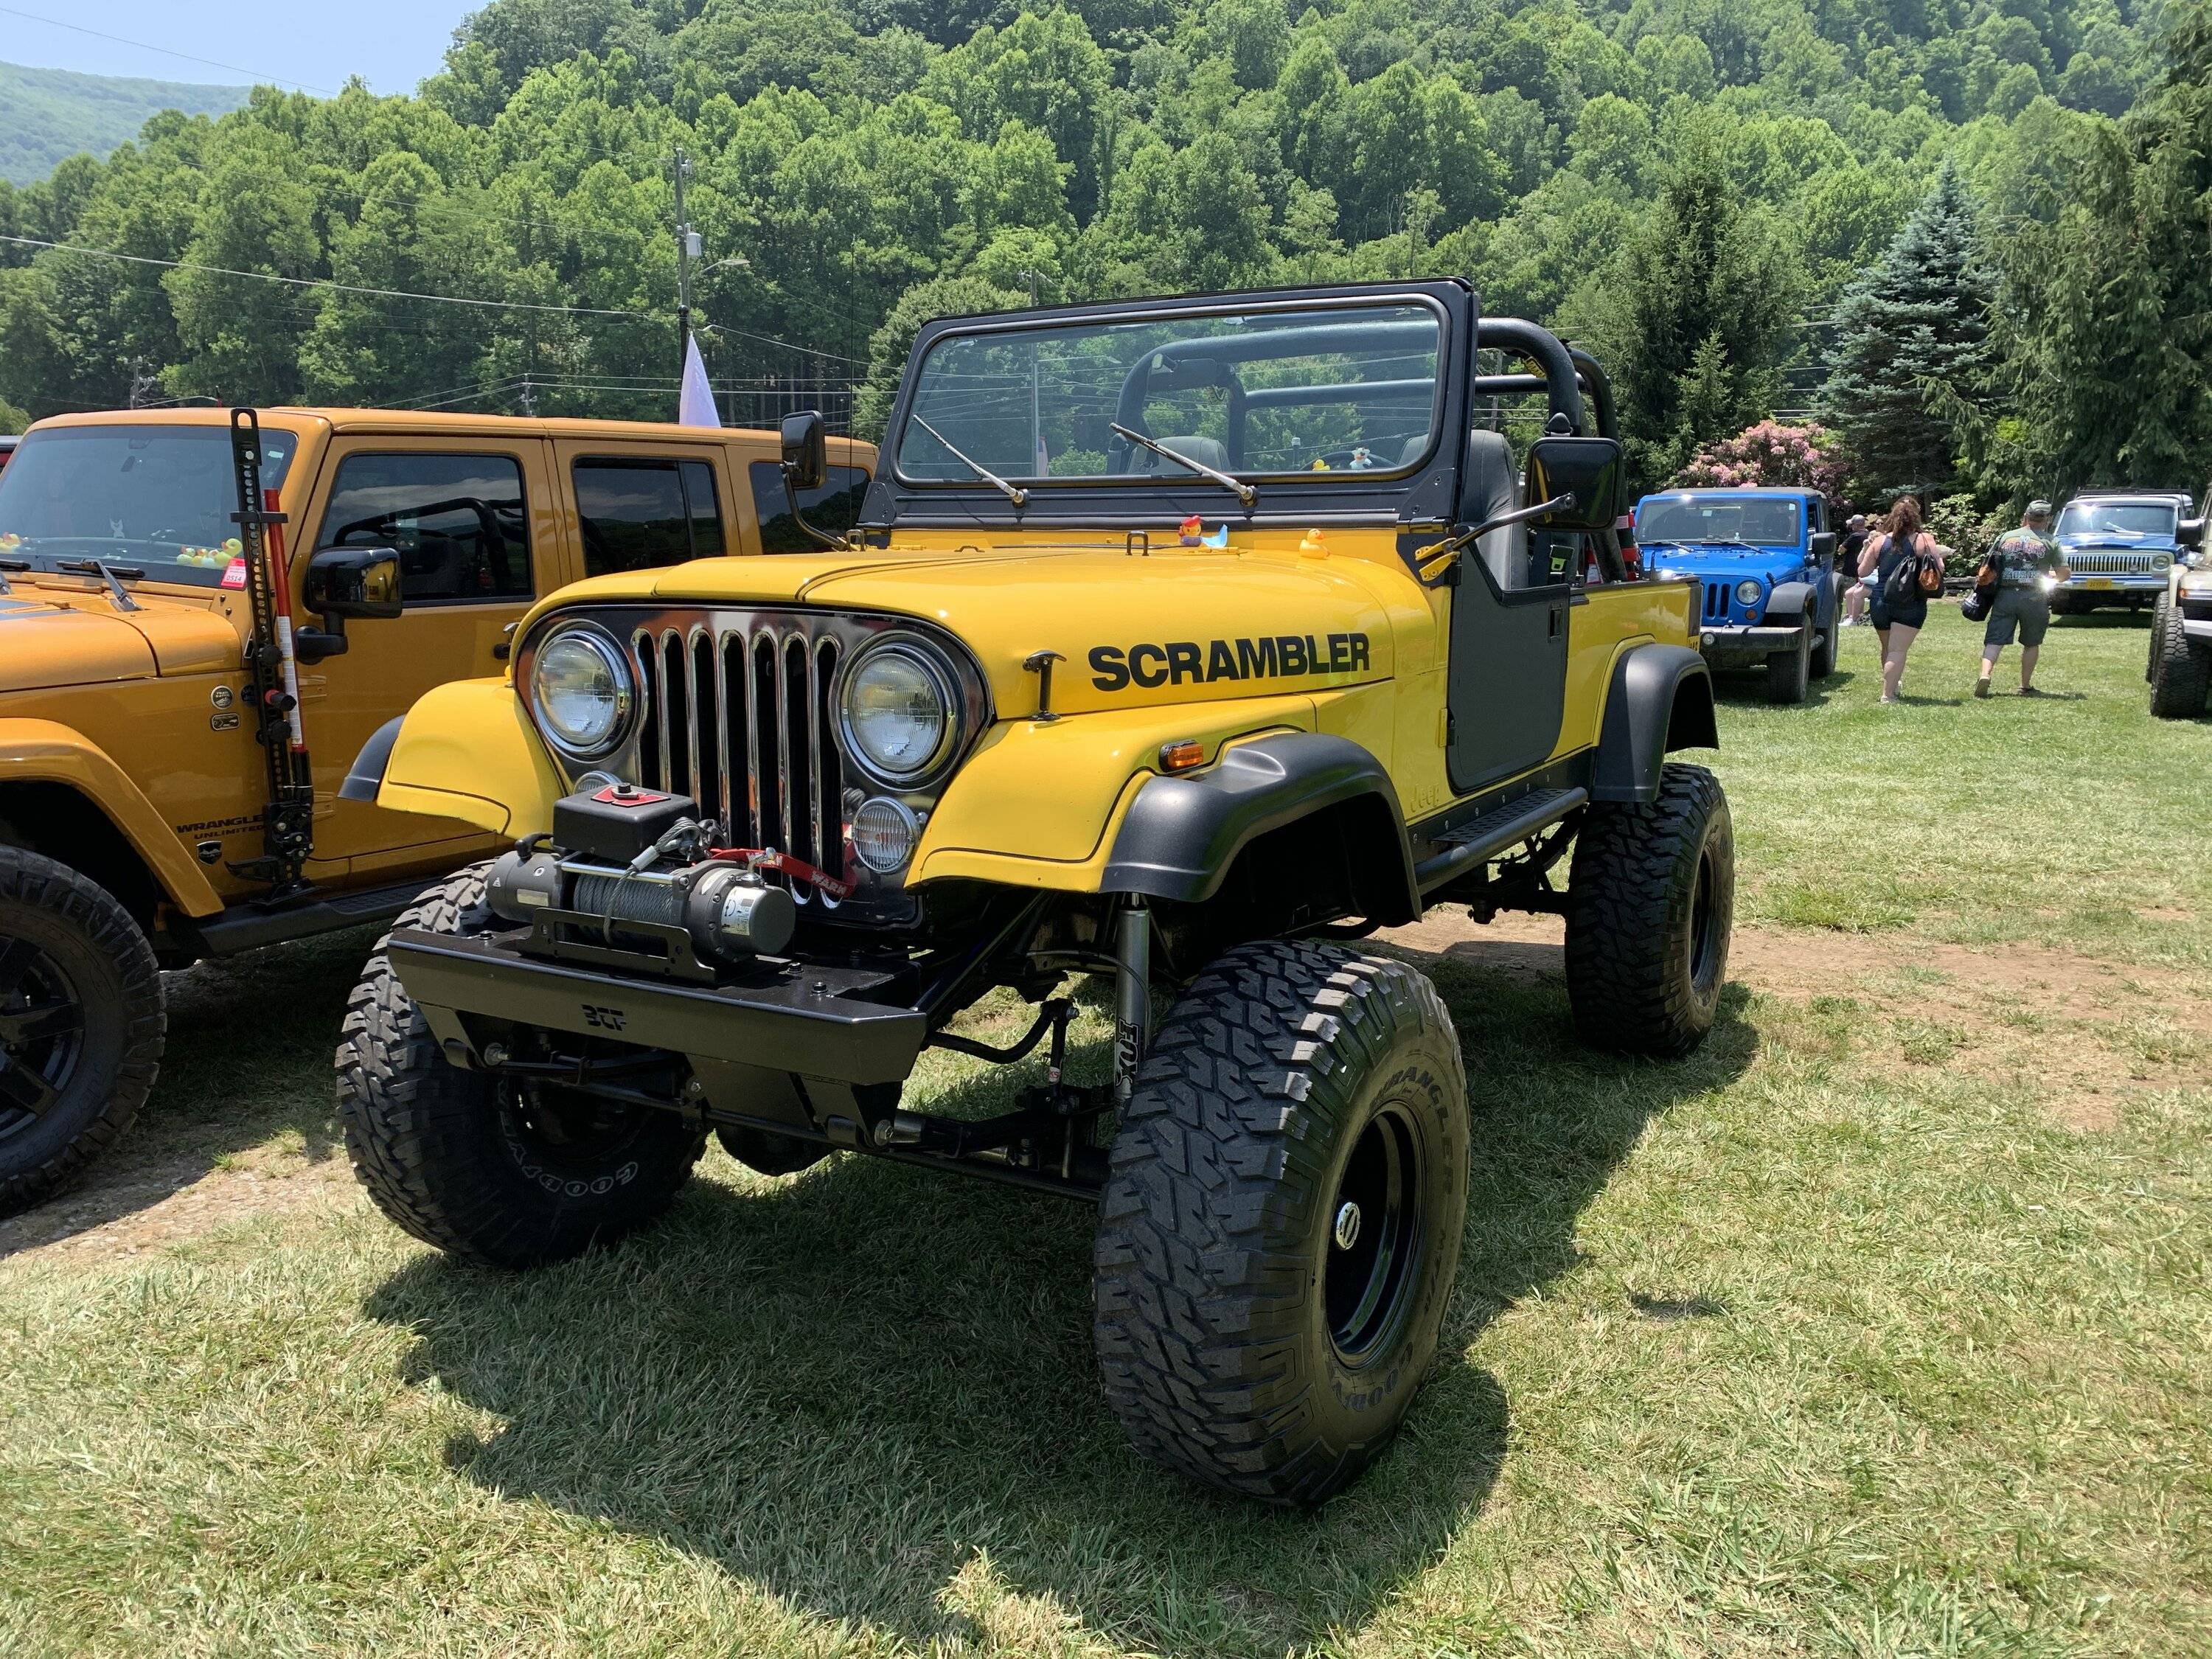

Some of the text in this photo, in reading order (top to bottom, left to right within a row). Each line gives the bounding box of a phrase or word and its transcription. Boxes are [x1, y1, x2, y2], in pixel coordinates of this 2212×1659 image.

[1088, 633, 1370, 692] SCRAMBLER
[1410, 782, 1440, 813] Jeep
[177, 814, 265, 833] WRANGLE
[193, 824, 265, 839] UNLIMITED
[745, 852, 784, 866] WN
[811, 871, 847, 895] WARN
[1114, 1018, 1139, 1086] FOX
[1368, 1066, 1453, 1196] WRANGLER
